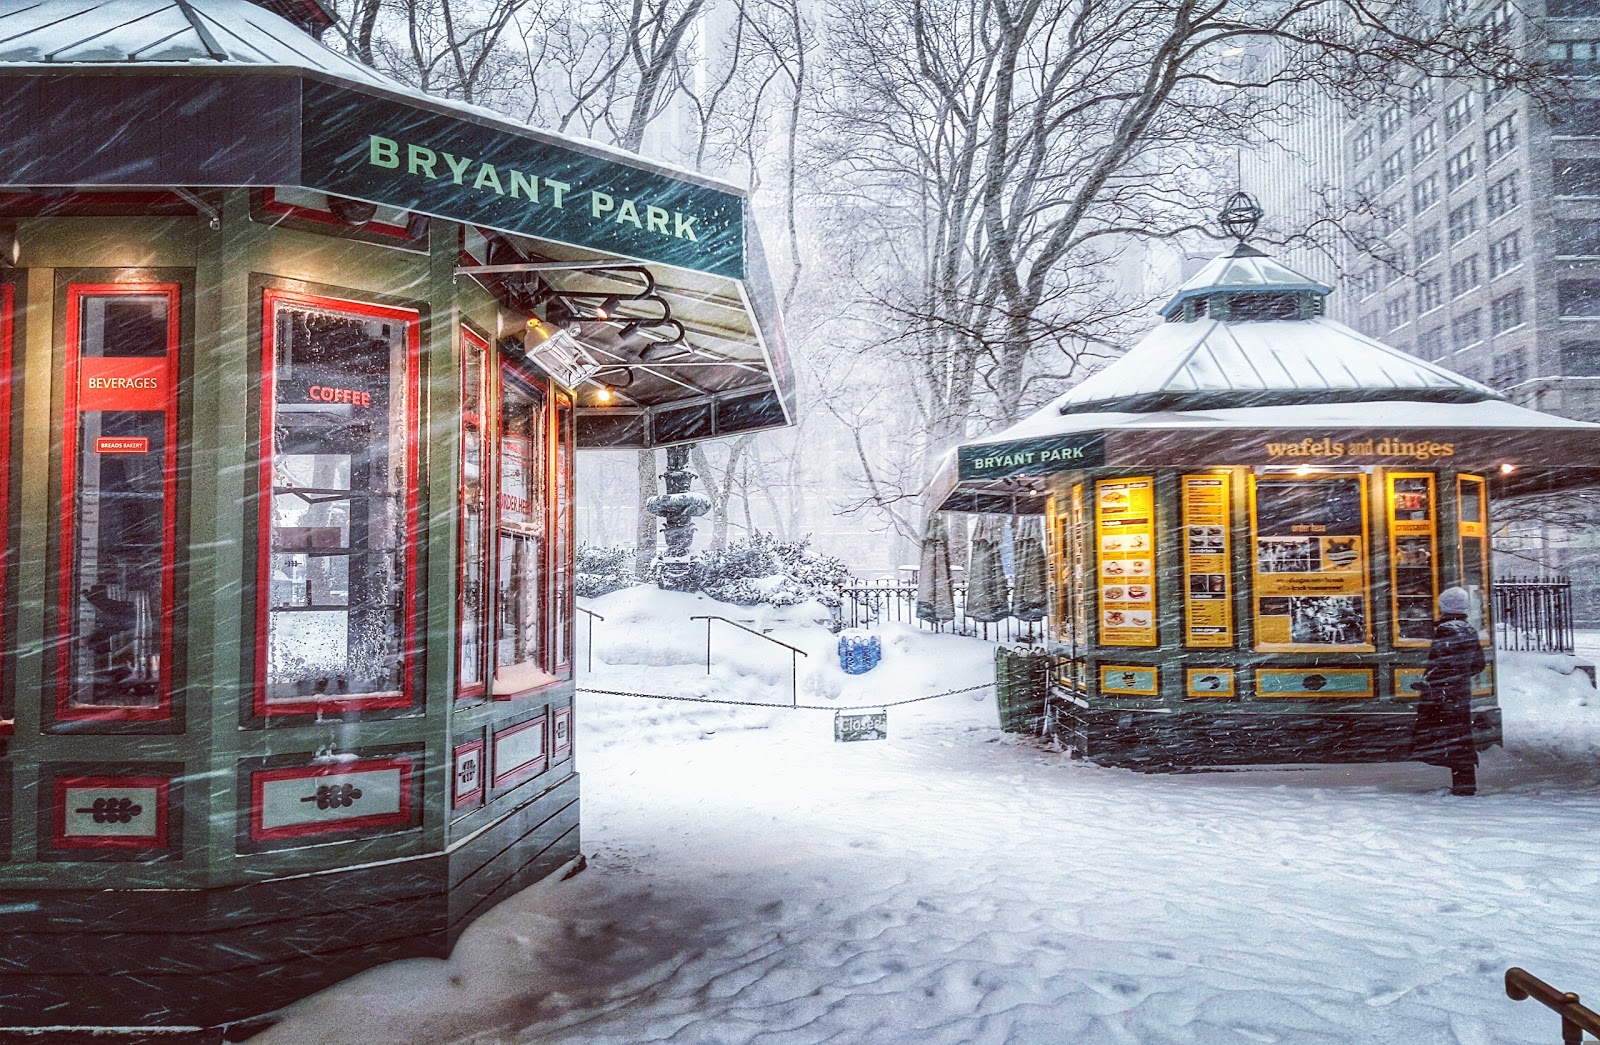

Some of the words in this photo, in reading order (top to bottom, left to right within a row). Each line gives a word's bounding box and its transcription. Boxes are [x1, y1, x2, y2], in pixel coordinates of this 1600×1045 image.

[369, 134, 571, 210] BRYANT
[591, 190, 699, 243] PARK
[88, 377, 158, 389] BEVERAGES
[309, 385, 370, 408] COFFEE
[974, 452, 1035, 470] BRYANT
[1041, 447, 1084, 462] PARK
[1266, 437, 1345, 456] wafels
[1349, 438, 1373, 456] and
[1377, 437, 1455, 460] dinges
